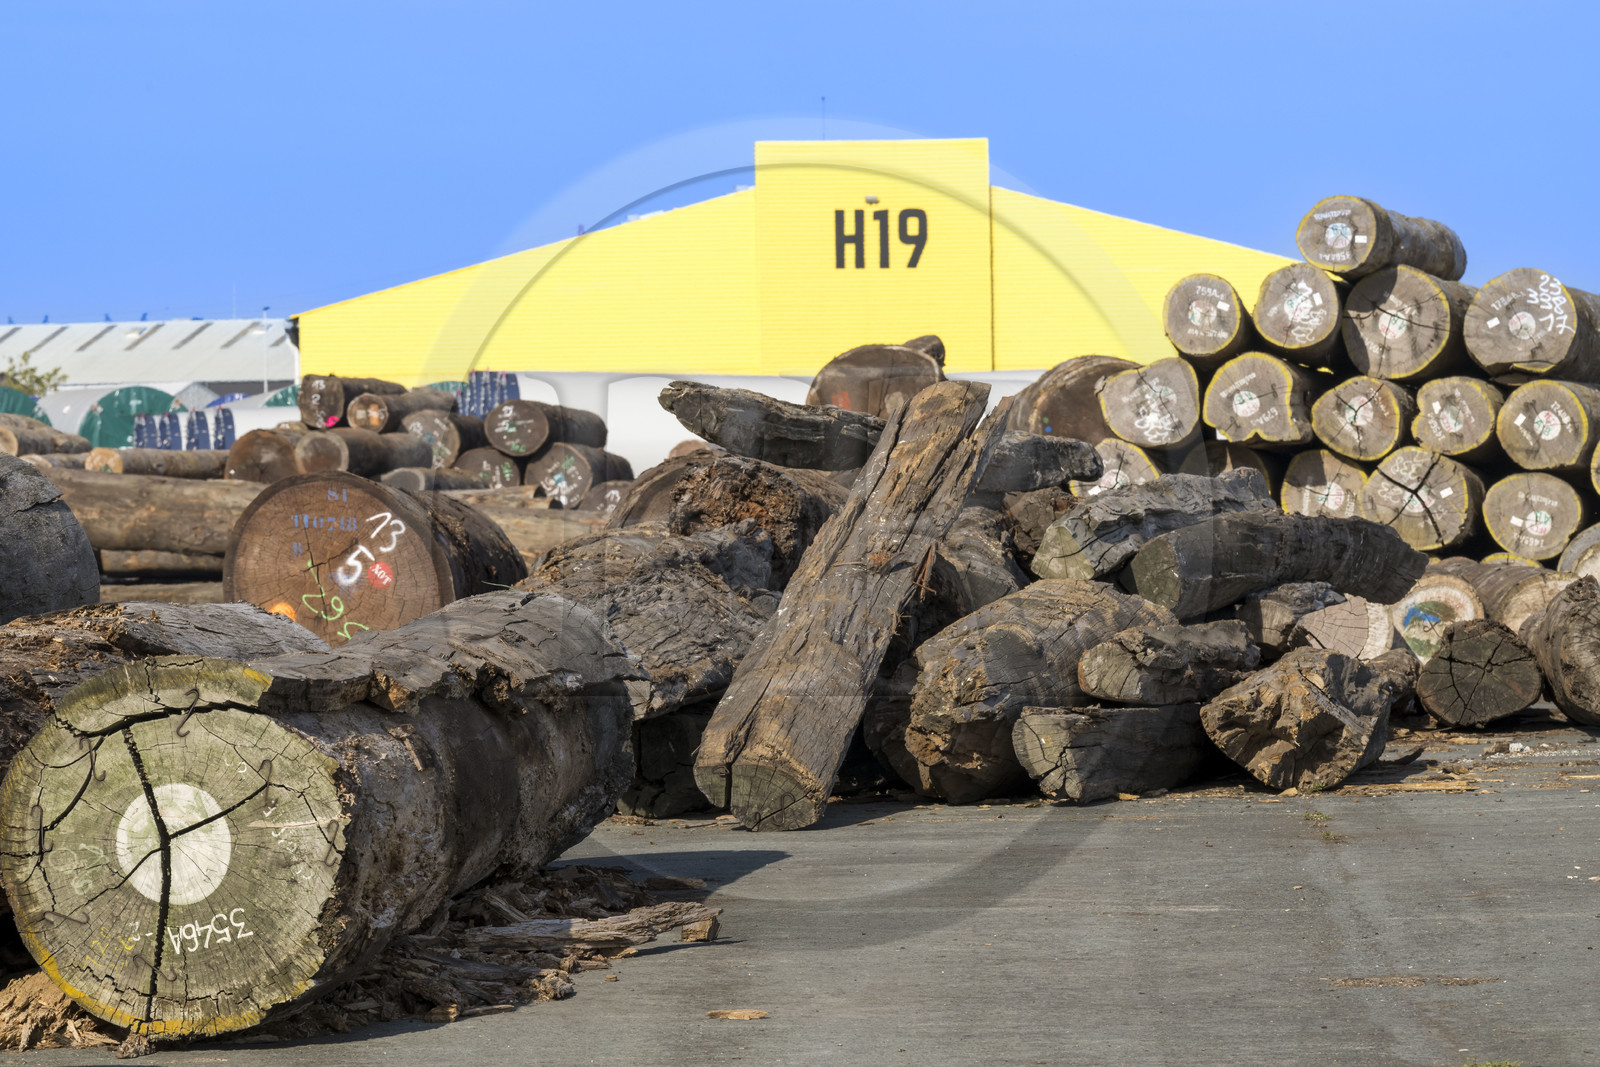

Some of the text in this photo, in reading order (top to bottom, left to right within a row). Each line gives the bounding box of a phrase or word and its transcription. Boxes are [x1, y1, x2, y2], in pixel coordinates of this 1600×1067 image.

[835, 208, 927, 269] H19
[1539, 274, 1562, 297] 23
[365, 511, 406, 553] 13
[337, 544, 375, 586] 5
